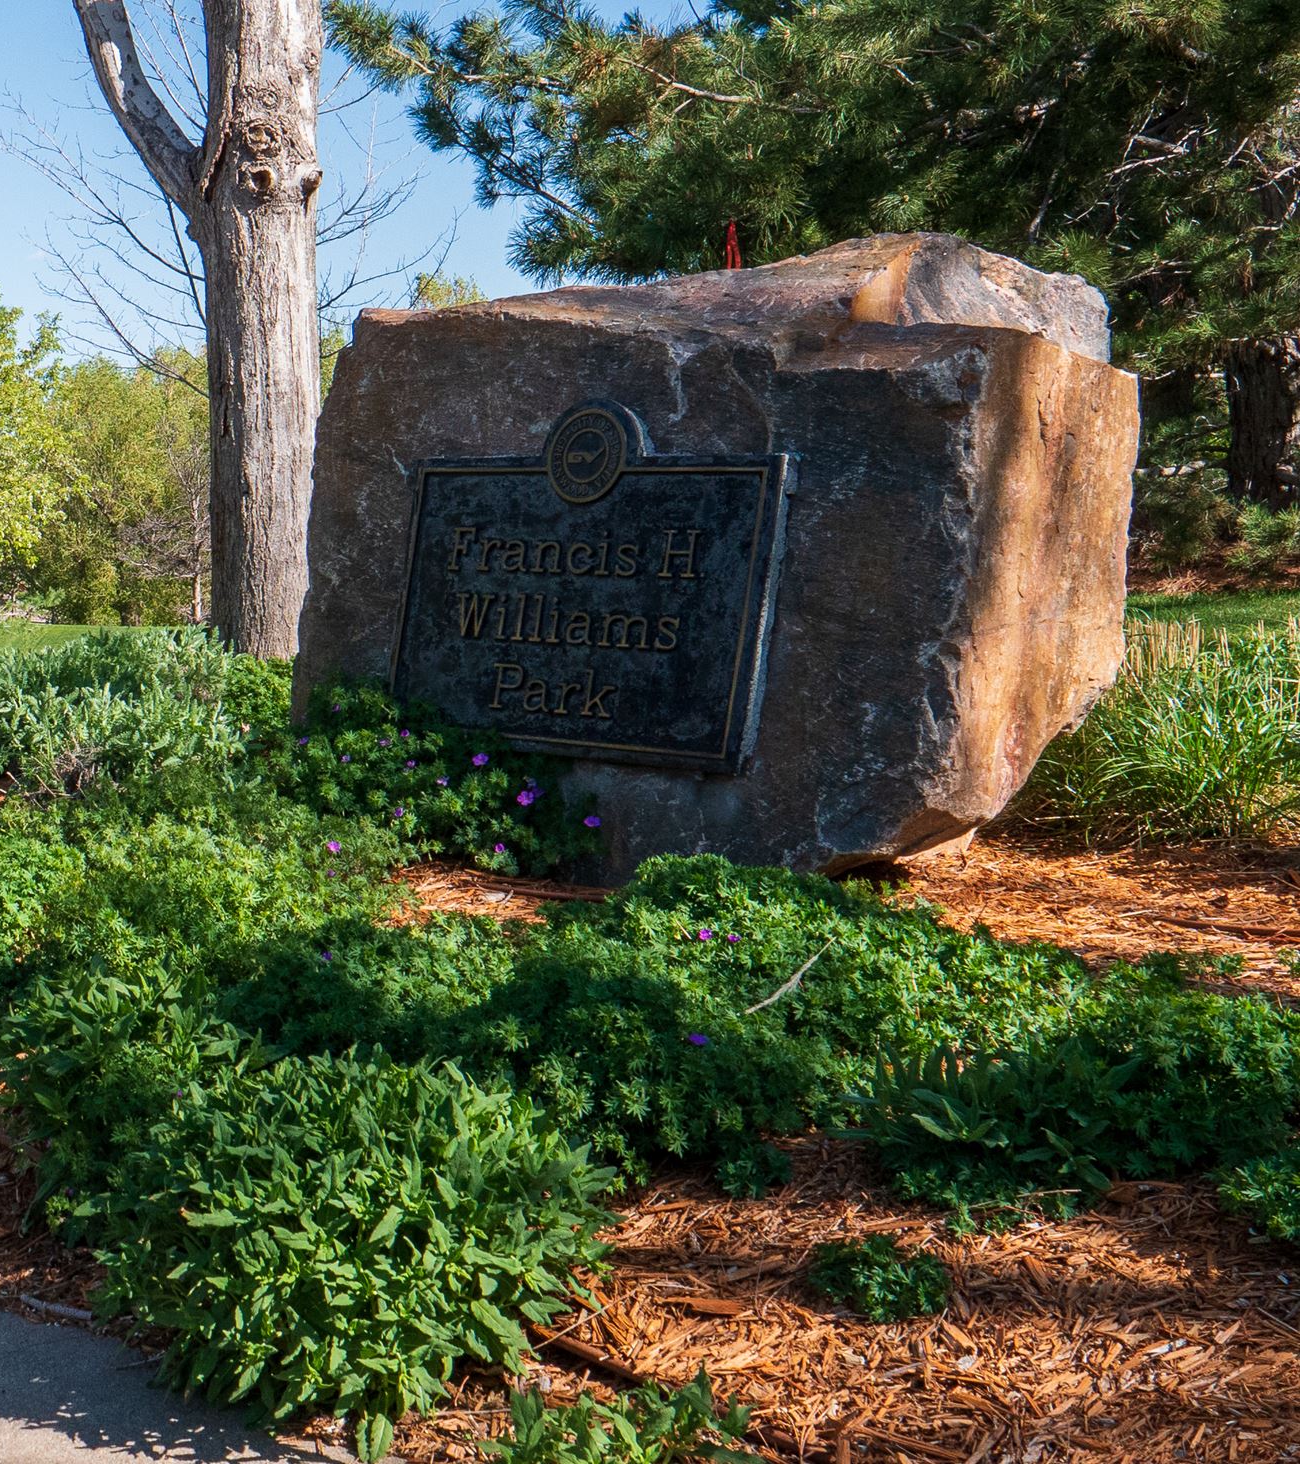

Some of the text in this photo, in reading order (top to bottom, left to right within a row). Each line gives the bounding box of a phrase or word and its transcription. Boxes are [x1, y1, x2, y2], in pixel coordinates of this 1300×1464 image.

[447, 527, 640, 577] Francis
[456, 591, 681, 651] Williams
[488, 662, 618, 718] Park
